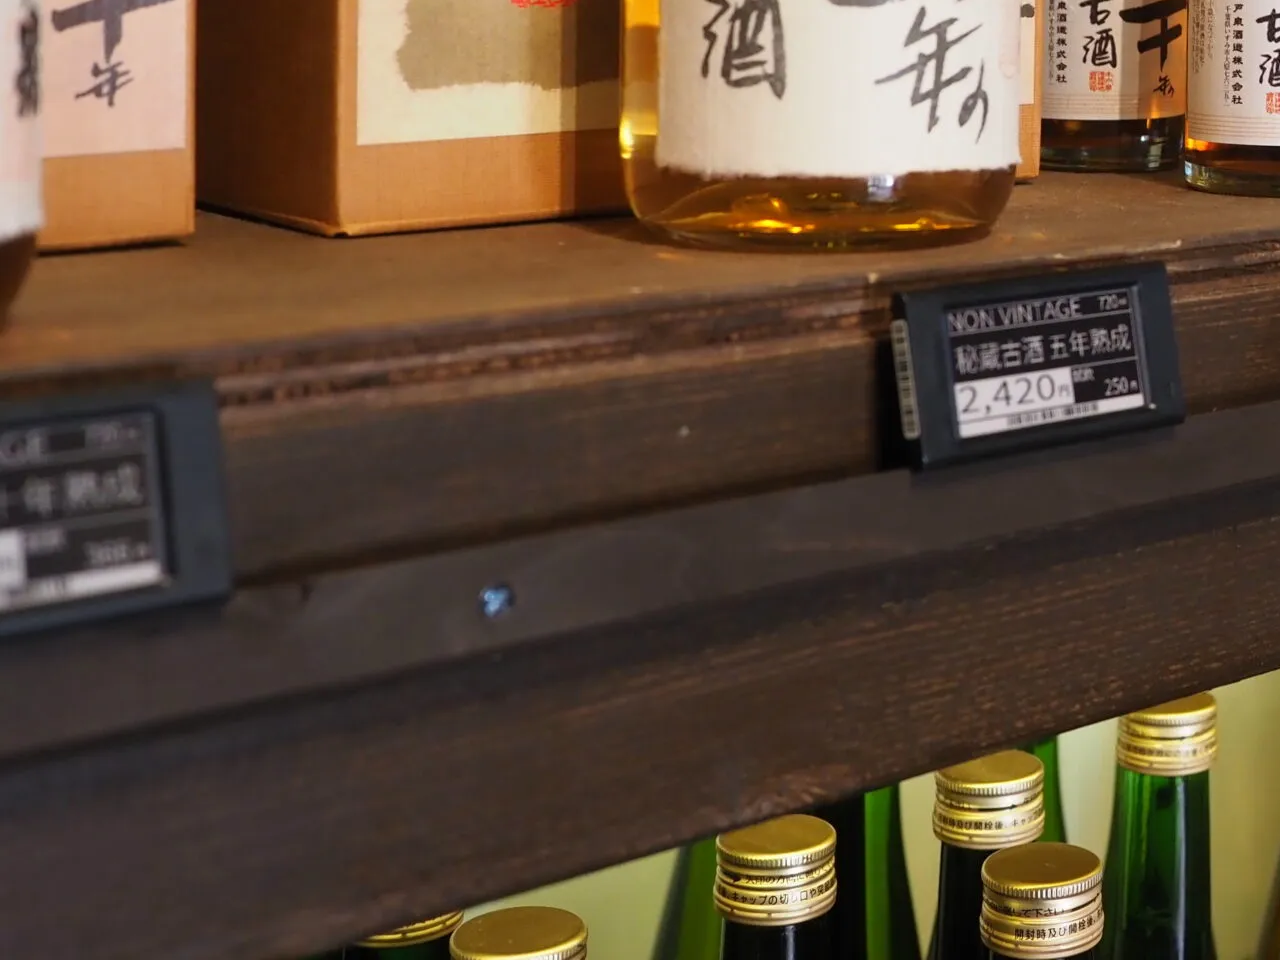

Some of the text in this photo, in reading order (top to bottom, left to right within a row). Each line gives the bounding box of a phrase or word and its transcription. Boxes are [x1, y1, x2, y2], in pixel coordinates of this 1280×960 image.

[999, 296, 1083, 326] VINTAGE
[954, 323, 1133, 376] 秘蔵古酒 五年熟成
